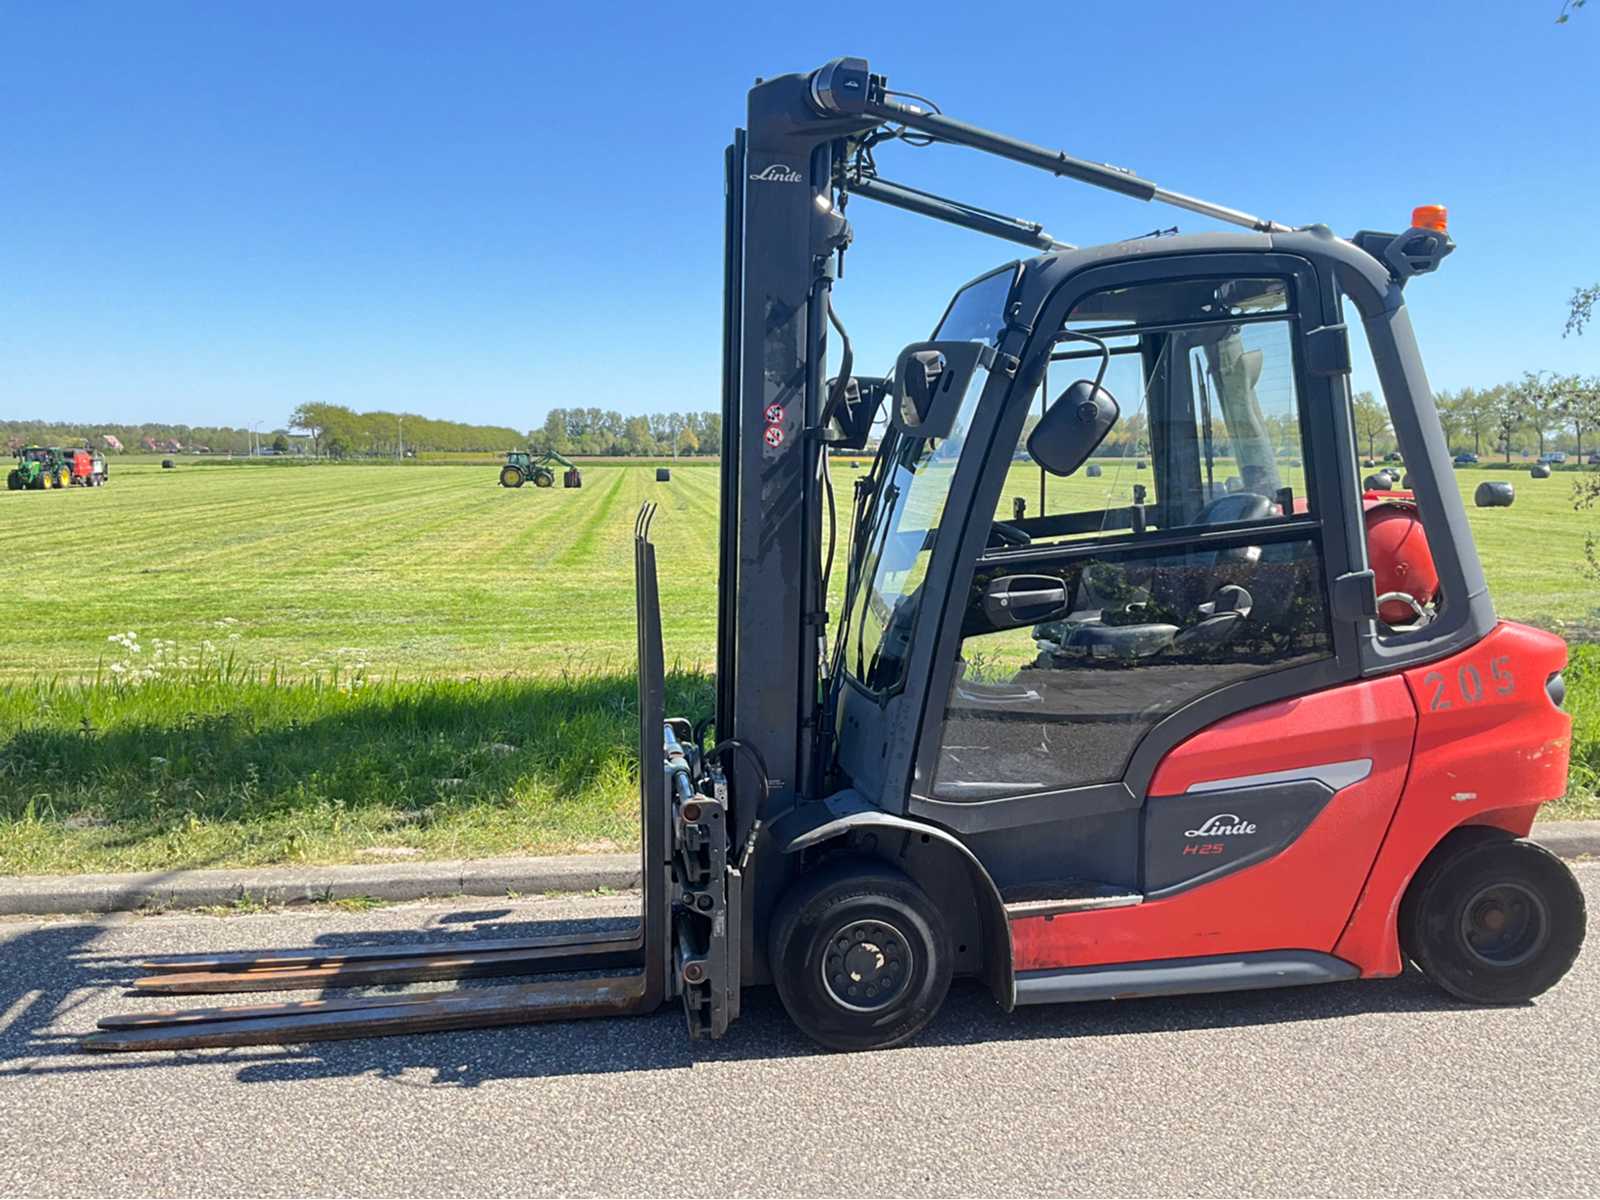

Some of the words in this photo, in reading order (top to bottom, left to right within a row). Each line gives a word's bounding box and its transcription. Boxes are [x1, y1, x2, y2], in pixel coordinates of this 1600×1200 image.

[750, 164, 802, 183] Linde
[1424, 655, 1516, 711] 205
[1184, 813, 1257, 837] Linde
[1183, 843, 1225, 855] H25
